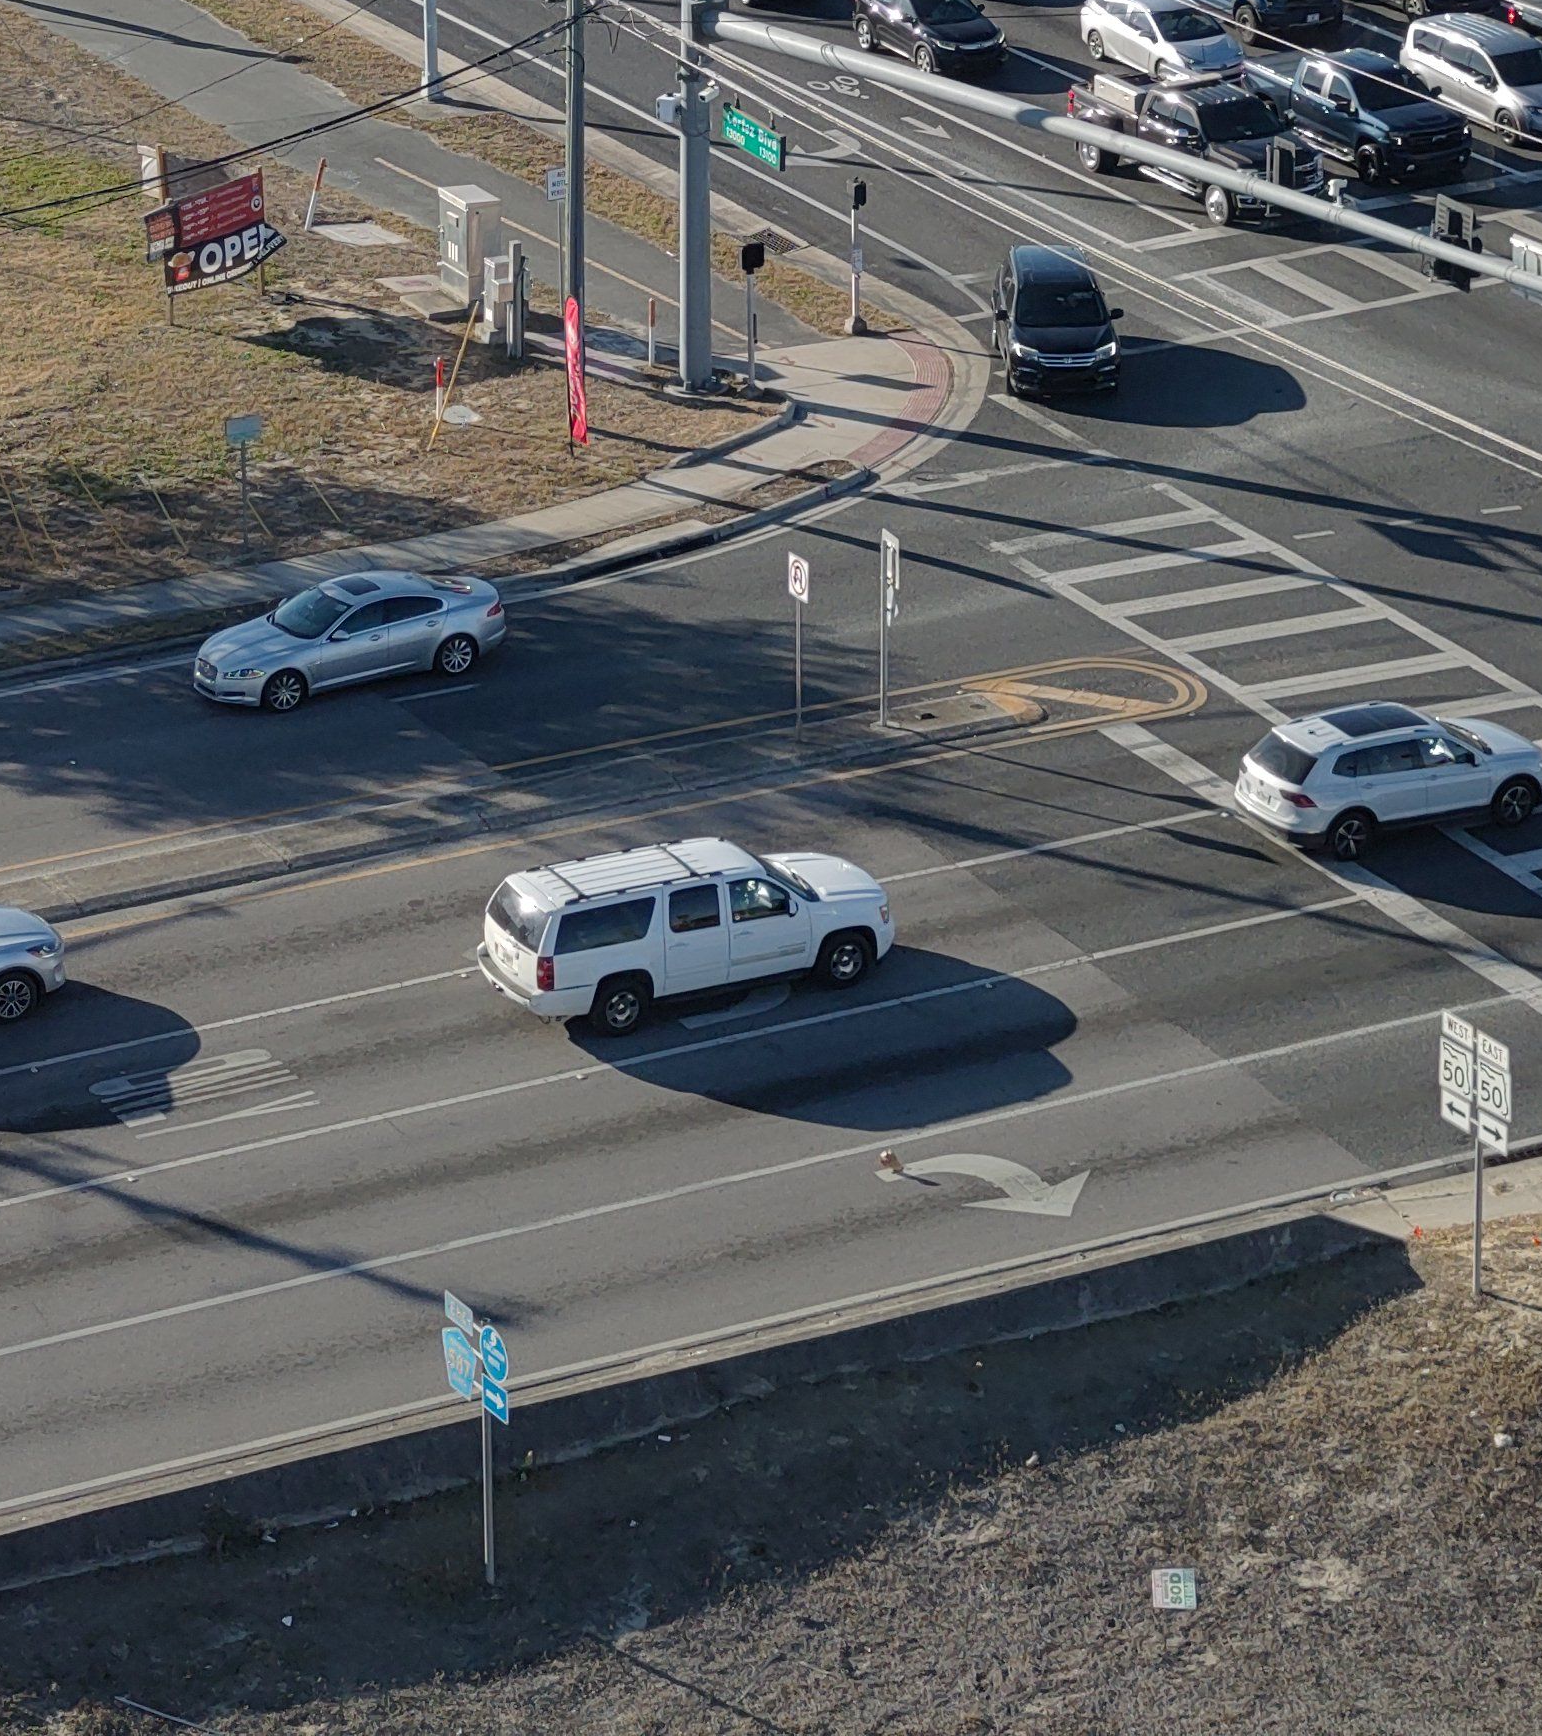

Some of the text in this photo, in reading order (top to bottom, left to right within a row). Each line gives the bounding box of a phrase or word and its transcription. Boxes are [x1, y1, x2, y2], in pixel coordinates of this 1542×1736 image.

[727, 114, 777, 151] Cortez Blvd
[166, 280, 197, 295] TKEOUT
[1447, 1015, 1469, 1041] WEST
[1482, 1039, 1504, 1063] EAST
[1443, 1060, 1465, 1088] 50
[89, 1048, 320, 1140] ONLY
[1480, 1080, 1503, 1109] 50
